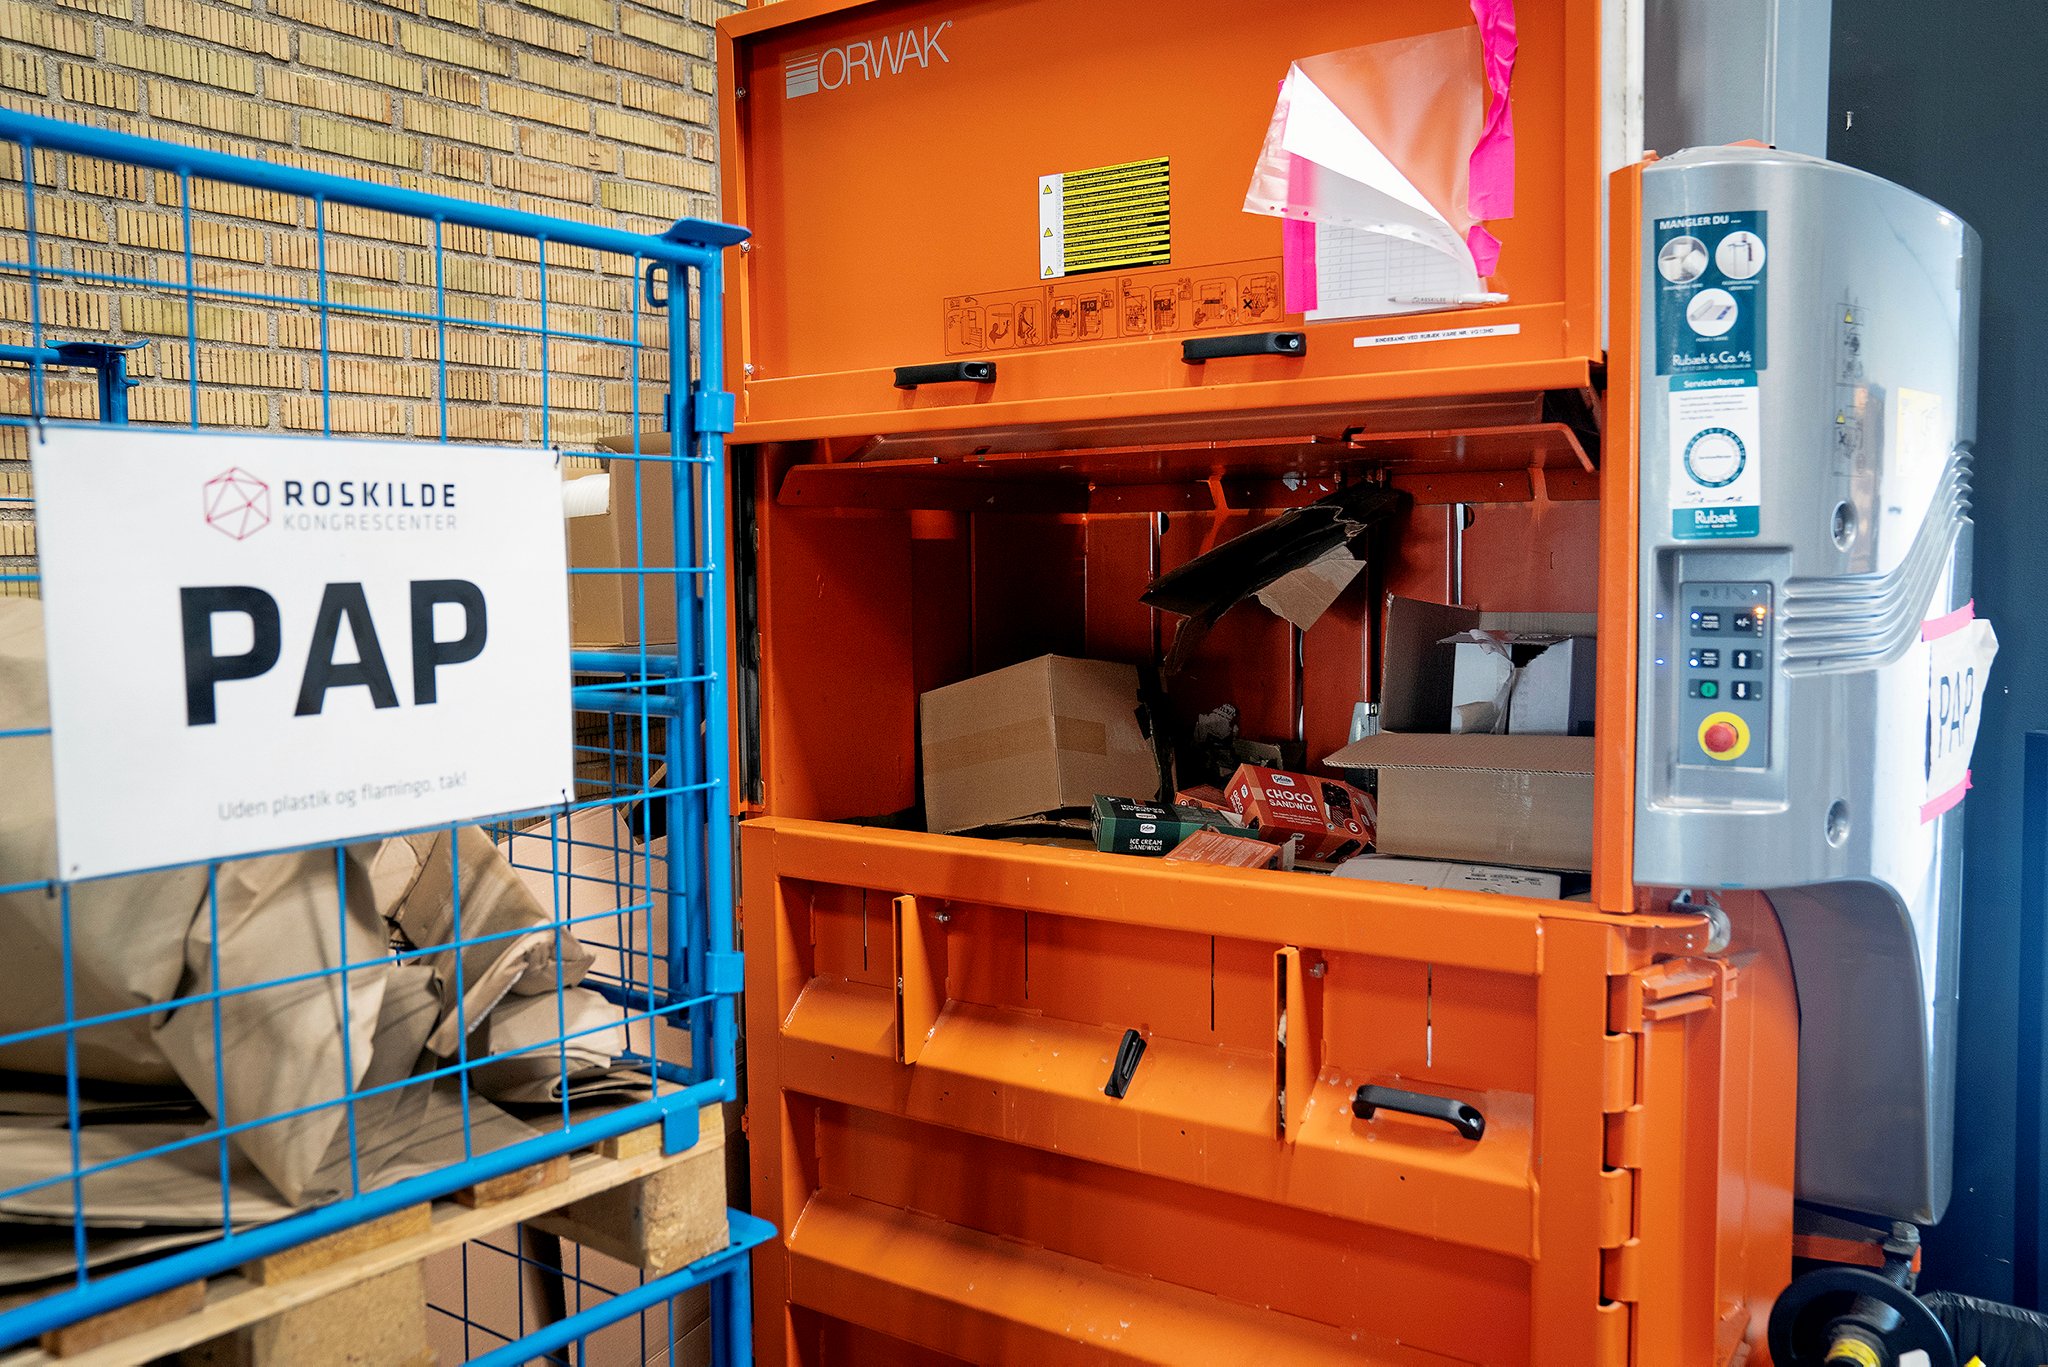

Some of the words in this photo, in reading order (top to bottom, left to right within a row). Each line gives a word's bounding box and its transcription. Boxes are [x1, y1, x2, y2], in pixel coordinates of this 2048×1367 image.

[818, 21, 950, 90] ORWAK
[1659, 216, 1711, 230] MANGLER
[1712, 215, 1730, 225] DU
[1708, 353, 1719, 364] &
[1683, 377, 1745, 389] Serviceeftersyn
[284, 480, 456, 507] ROSKILDE
[283, 512, 458, 531] KONGRESCENTER
[180, 579, 488, 727] PAP
[1937, 666, 1974, 759] PAP
[217, 795, 268, 821] Uden
[272, 787, 332, 817] plastik
[335, 789, 357, 808] og
[439, 770, 467, 789] tak!
[1265, 788, 1314, 804] CHOCO
[1268, 799, 1318, 813] SANDWICH
[1348, 822, 1359, 833] 6
[1140, 838, 1163, 846] CREAM
